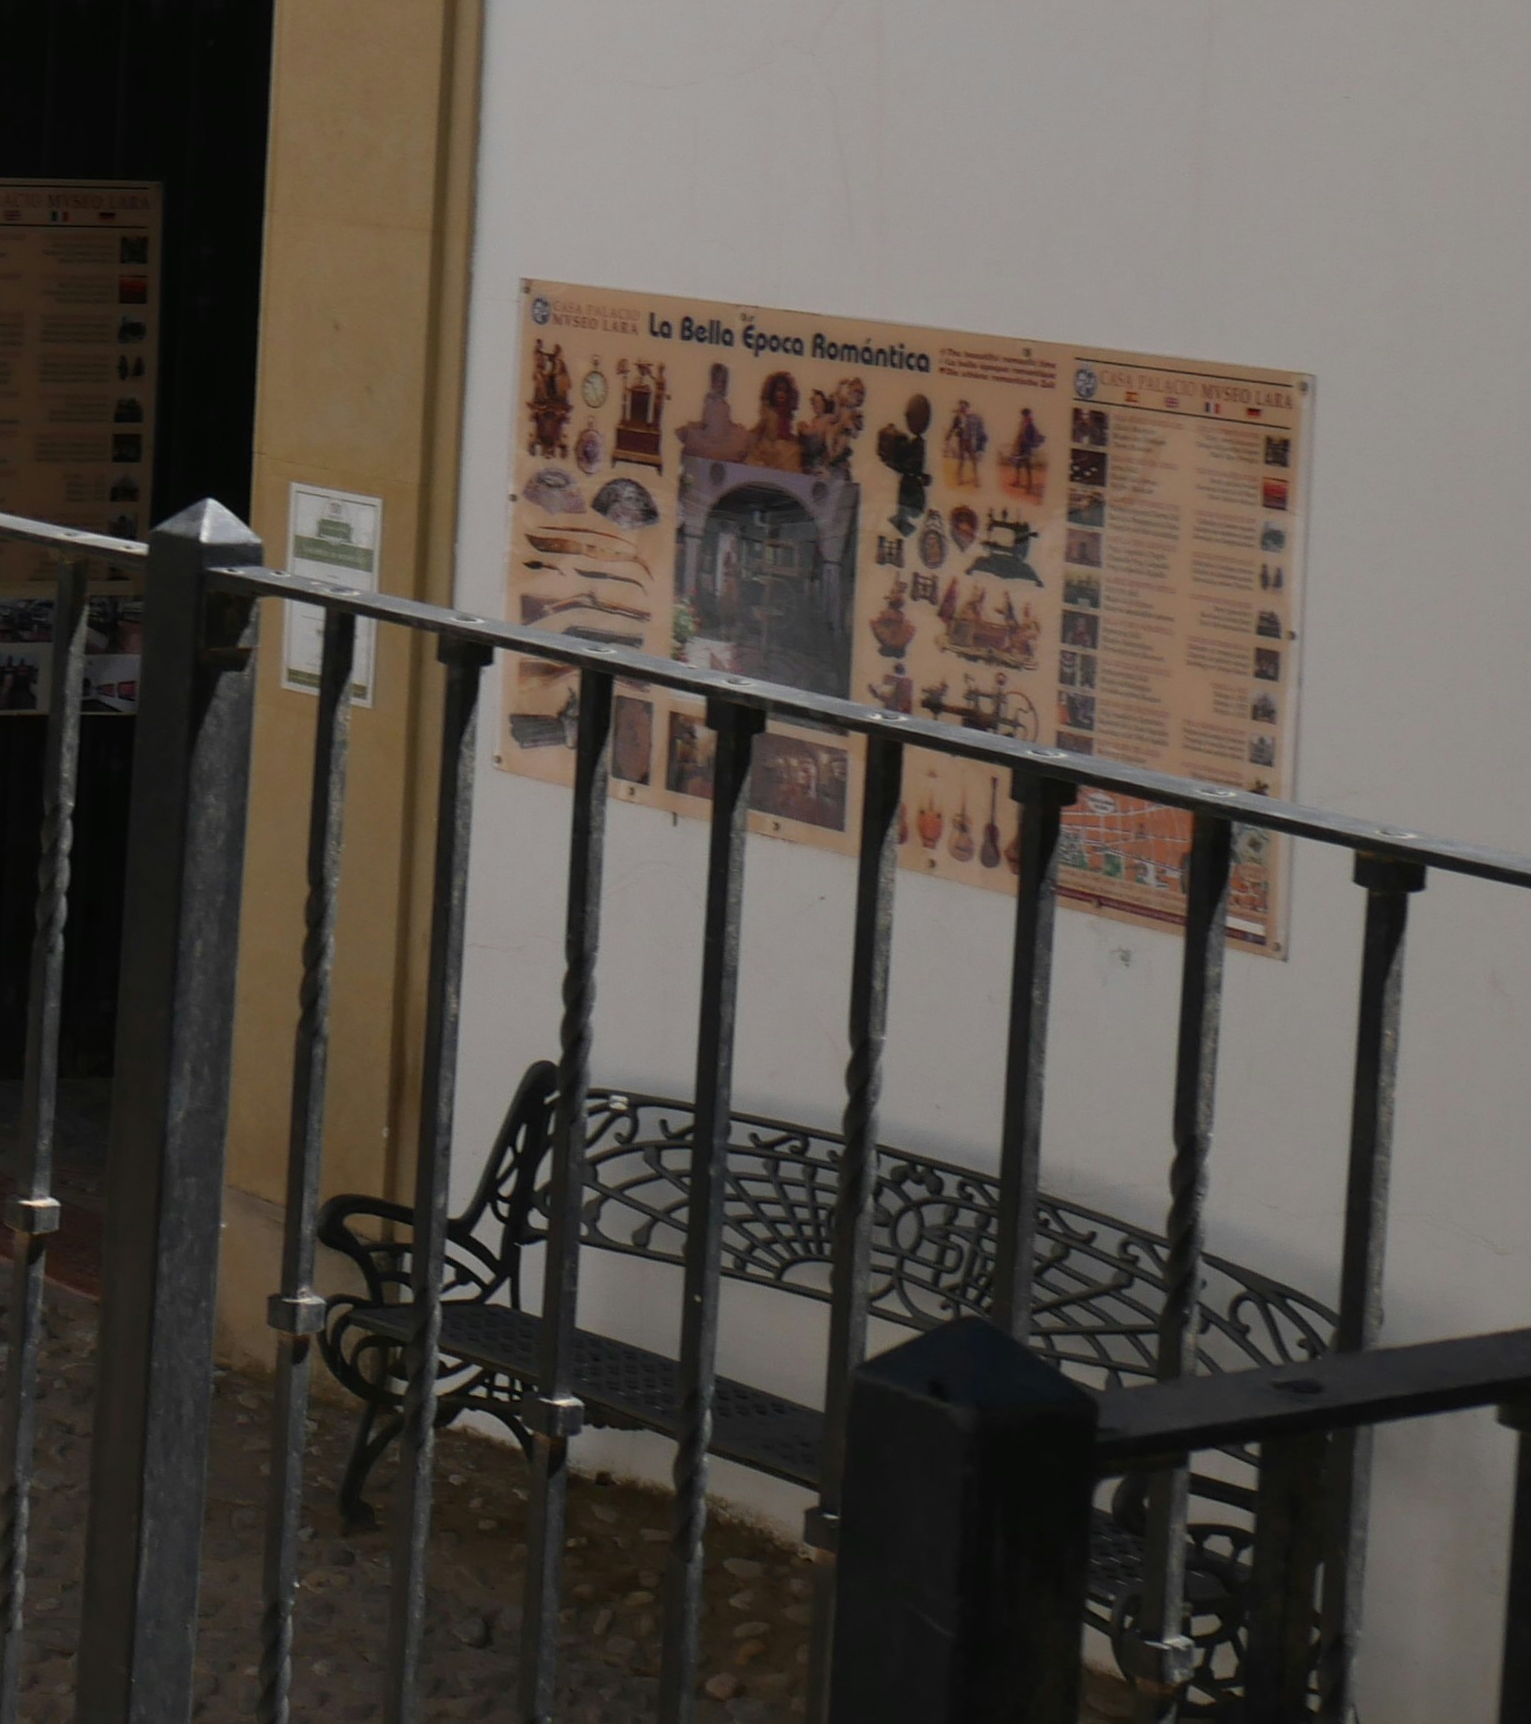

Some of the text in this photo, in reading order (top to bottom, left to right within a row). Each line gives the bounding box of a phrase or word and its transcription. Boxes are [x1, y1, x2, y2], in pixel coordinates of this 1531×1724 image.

[602, 319, 639, 335] LARA
[648, 311, 673, 340] La
[680, 316, 735, 347] Bella
[812, 332, 931, 373] Romántica
[1100, 370, 1133, 389] CASA
[1137, 373, 1196, 396] PALACIO
[1254, 390, 1294, 410] LARA
